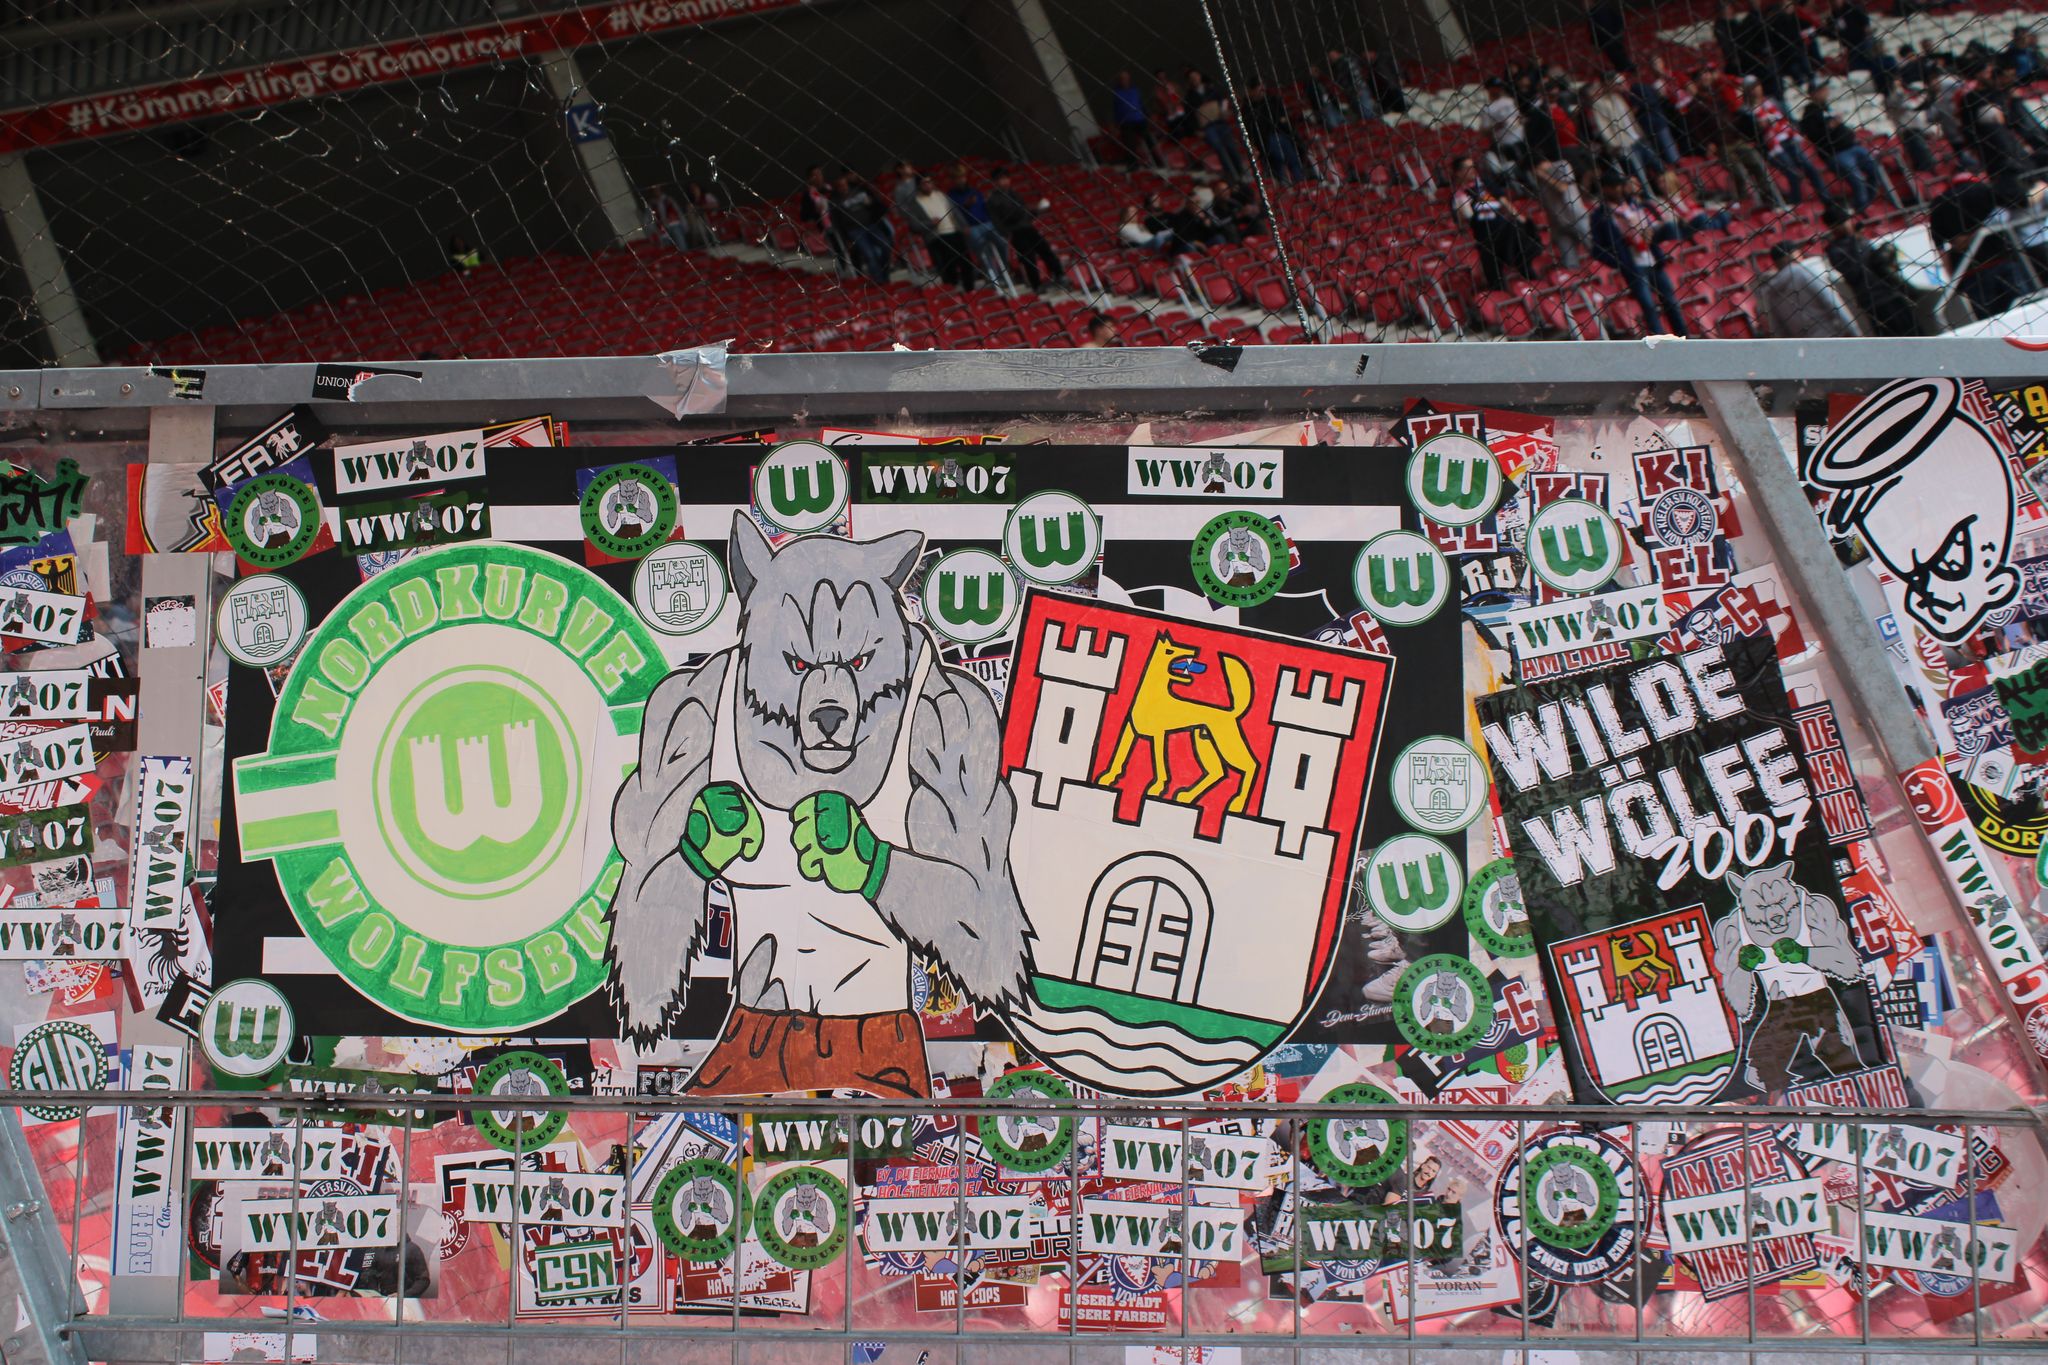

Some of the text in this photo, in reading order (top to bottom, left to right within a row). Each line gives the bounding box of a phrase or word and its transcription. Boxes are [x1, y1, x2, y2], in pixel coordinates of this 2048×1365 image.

[67, 32, 522, 135] #KömmerlingForTomorrow
[572, 110, 592, 137] K
[316, 375, 354, 388] UNION
[586, 467, 670, 507] WILDE WÖLFE
[240, 524, 314, 562] WOLFSBURG
[591, 522, 668, 552] WOLFSBURG
[1197, 514, 1282, 556] WILDE WÖLFE
[1202, 571, 1281, 602] WOLFSBURG
[291, 561, 647, 739] NORDKURVE
[1482, 645, 1746, 793] WILDE
[1521, 727, 1811, 888] WÖLFE
[1651, 796, 1812, 891] 2007
[1402, 1013, 1480, 1050] WOLFSBURG
[539, 1250, 615, 1293] CSN
[1530, 1228, 1634, 1276] ZWEI VIER EINS
[1336, 1265, 1356, 1279] VON
[1434, 1281, 1482, 1292] VORAN
[1060, 1308, 1166, 1323] USERE FARBEN
